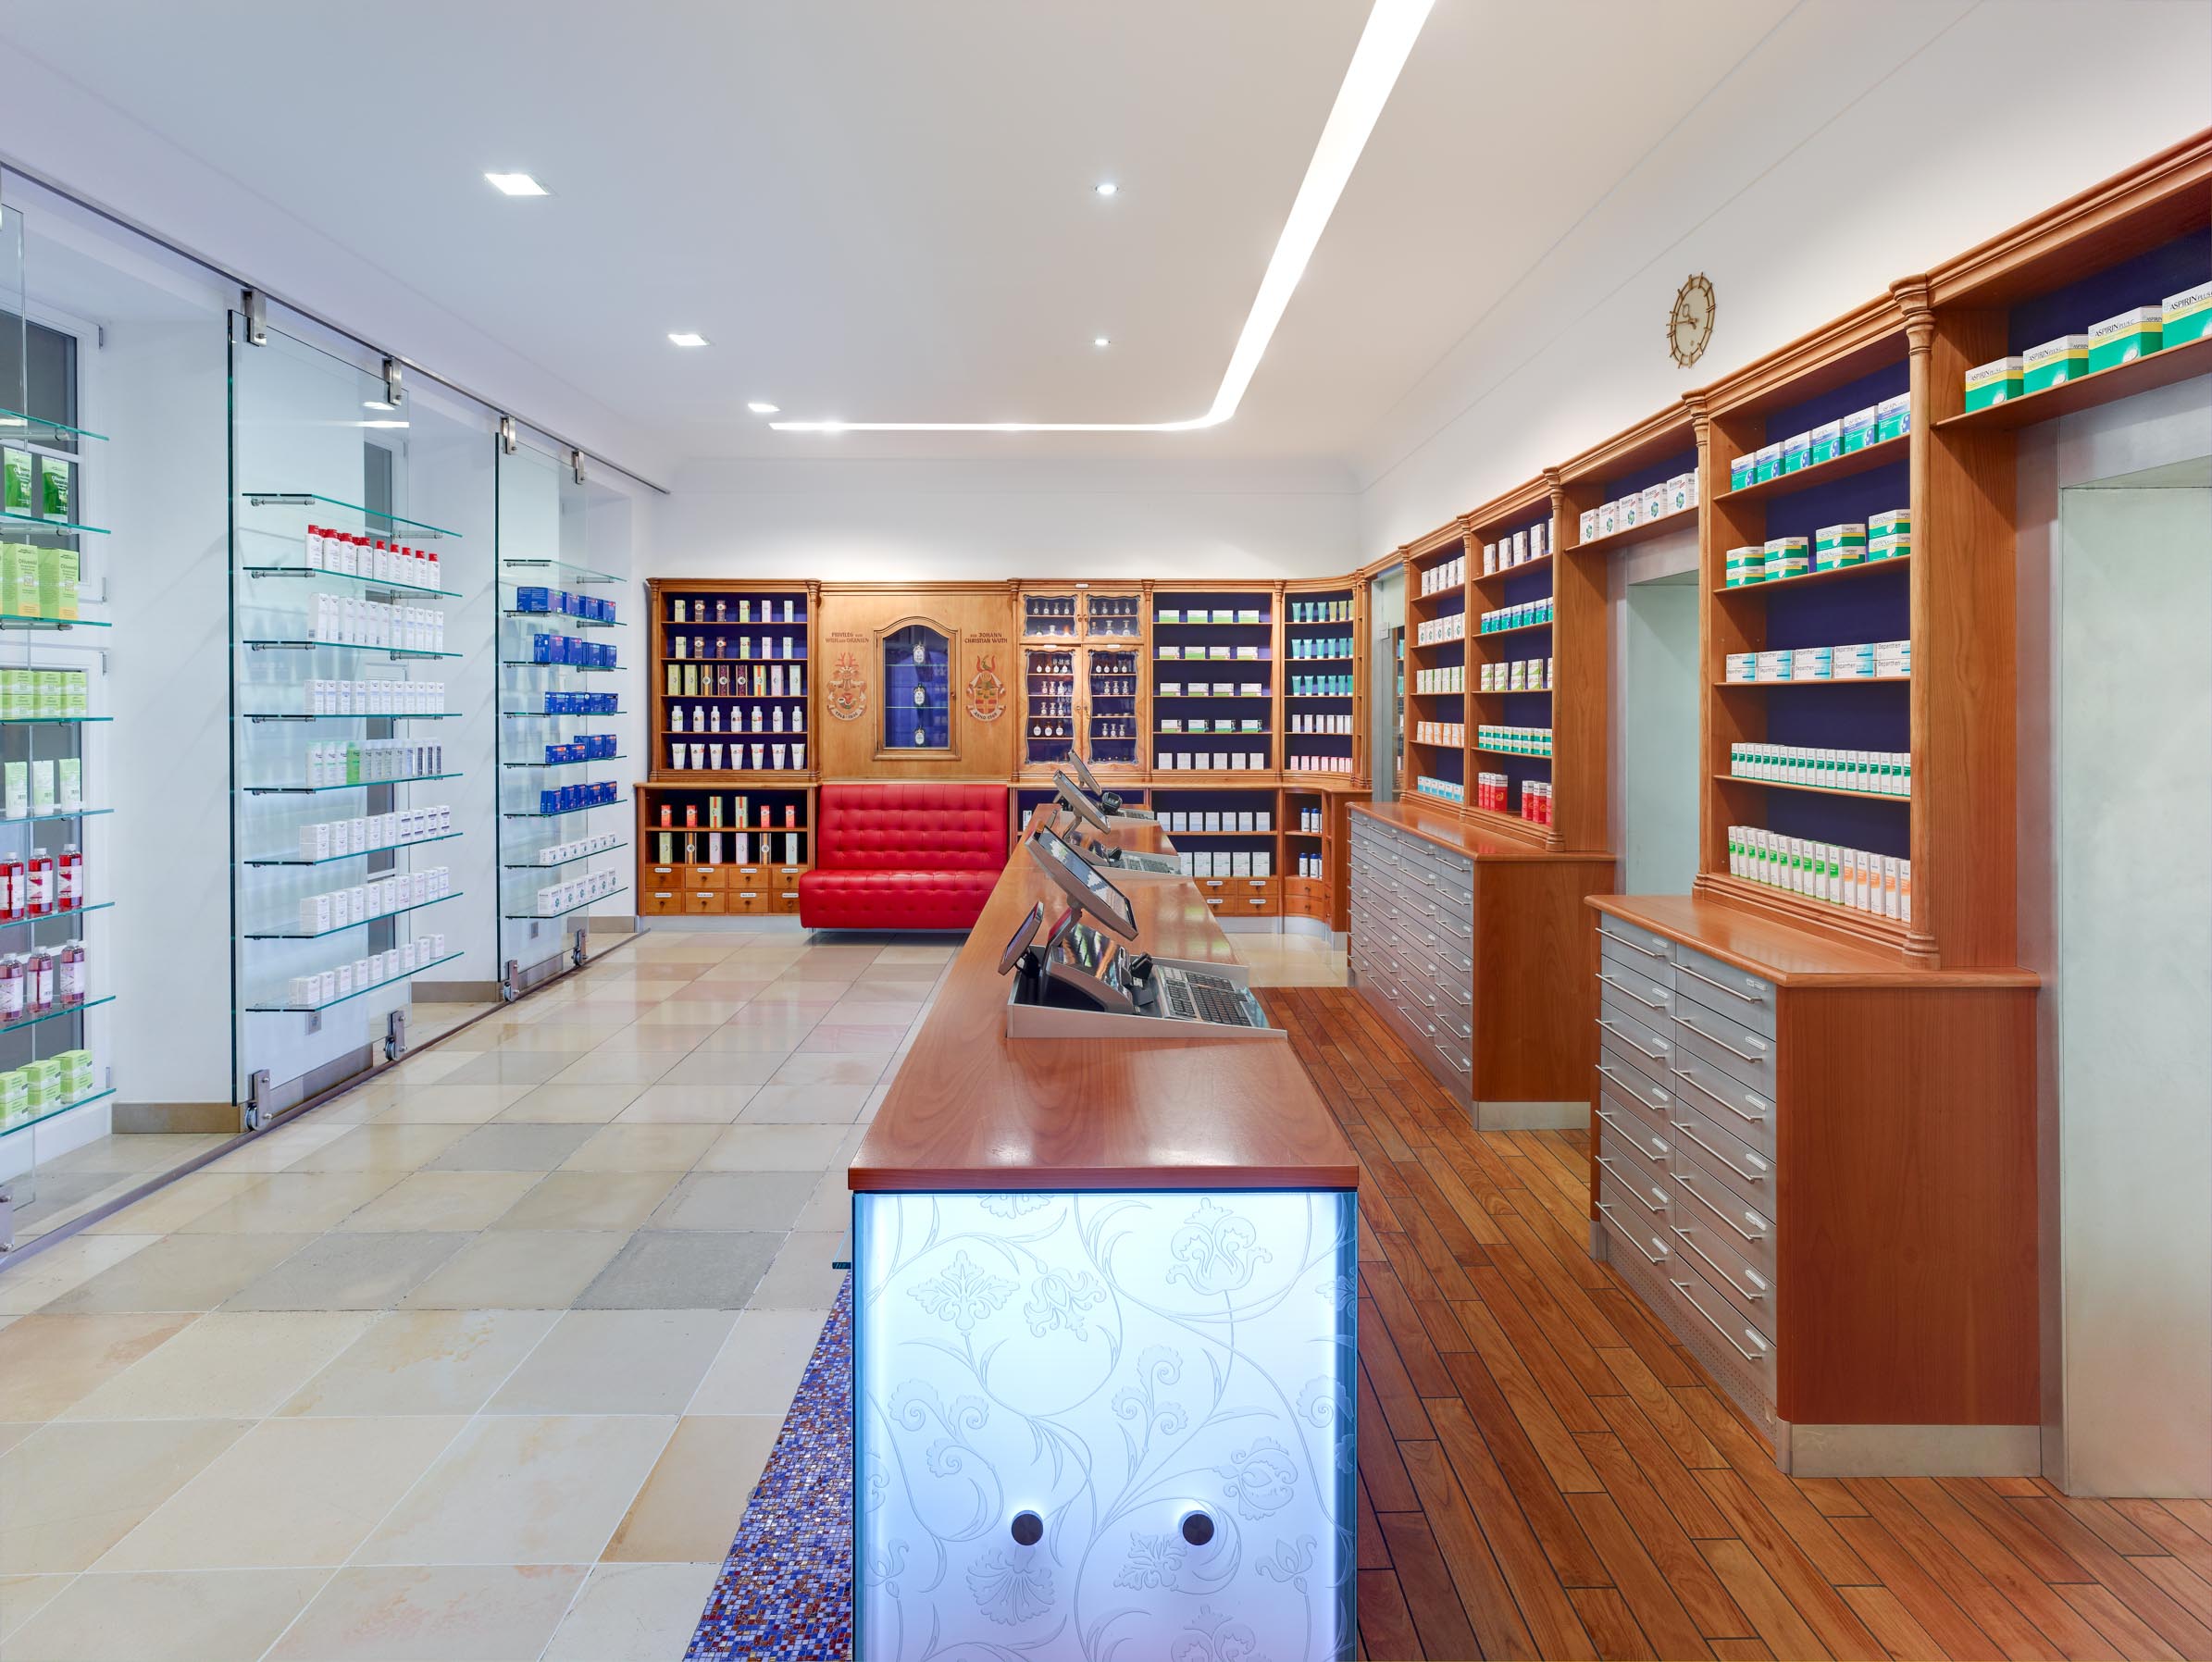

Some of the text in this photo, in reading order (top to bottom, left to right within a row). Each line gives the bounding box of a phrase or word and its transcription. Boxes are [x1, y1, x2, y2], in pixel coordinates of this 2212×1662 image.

[2169, 295, 2197, 311] ASPIRIN
[2094, 323, 2119, 337] ASPIRIN
[2029, 349, 2049, 362] ASPIRIN
[1970, 369, 1990, 381] ASPIRIN
